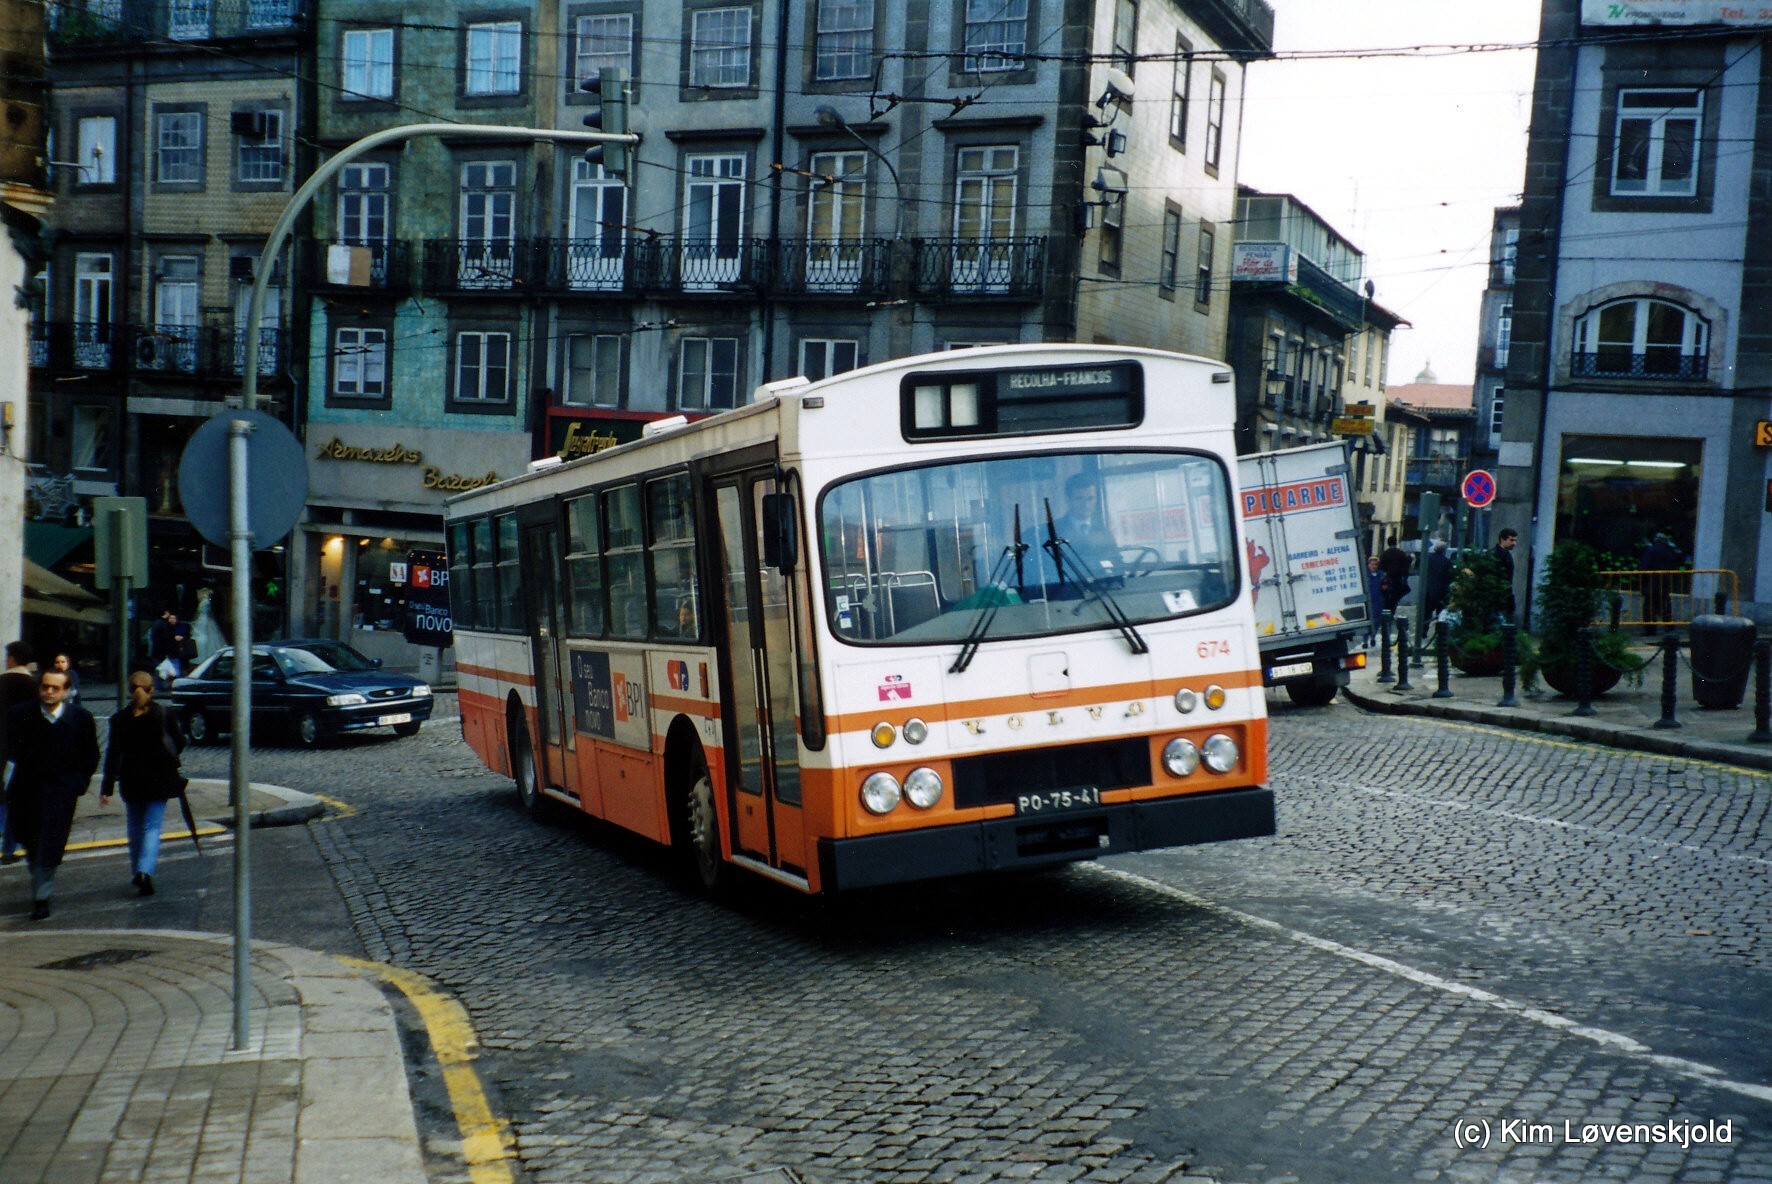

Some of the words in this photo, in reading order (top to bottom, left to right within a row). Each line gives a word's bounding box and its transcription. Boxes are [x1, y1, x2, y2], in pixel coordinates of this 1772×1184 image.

[420, 464, 500, 491] Barcel
[1245, 483, 1342, 513] PICARNE
[431, 569, 450, 587] BP
[416, 614, 453, 633] novo
[1196, 639, 1232, 659] 674
[588, 681, 610, 710] Banco
[626, 681, 644, 719] BPI
[961, 700, 1146, 735] VOLVO
